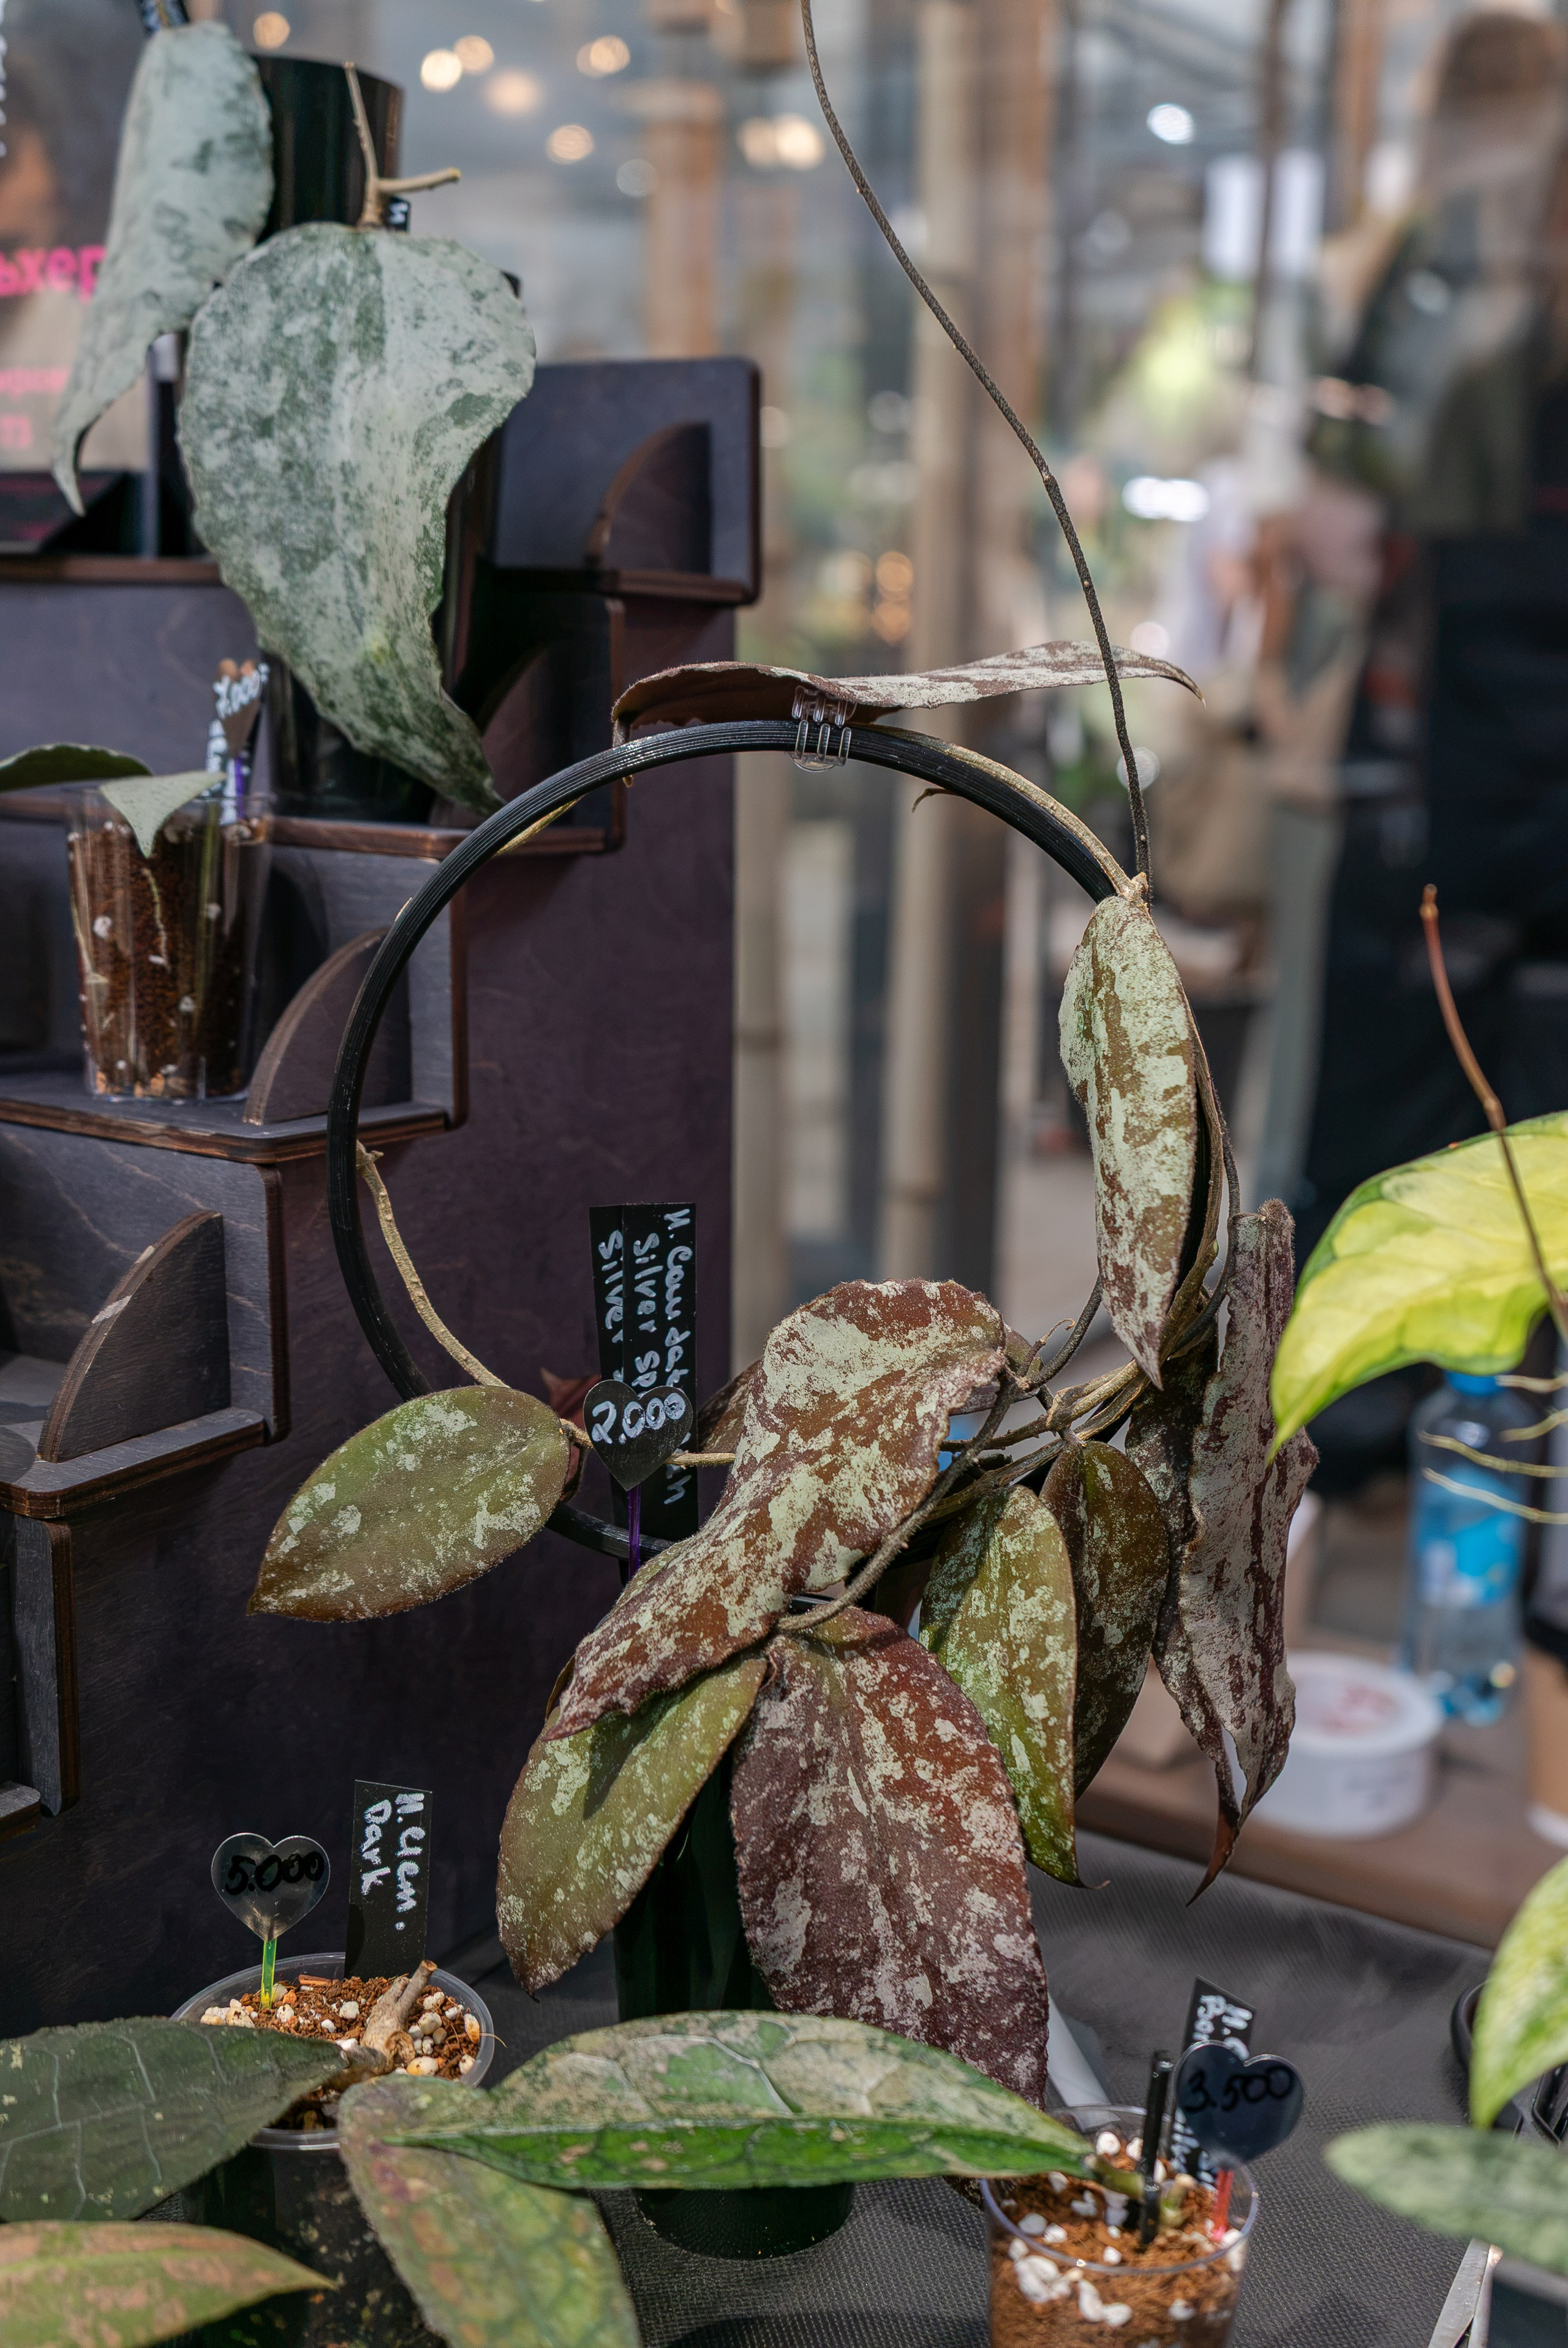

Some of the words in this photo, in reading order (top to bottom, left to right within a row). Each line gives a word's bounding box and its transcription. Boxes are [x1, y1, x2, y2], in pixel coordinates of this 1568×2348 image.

[633, 1233, 663, 1332] Silver
[592, 1393, 686, 1444] 2.000
[360, 1800, 393, 1895] Dark
[225, 1851, 325, 1896] 5.000
[1183, 2066, 1294, 2112] 3.500
